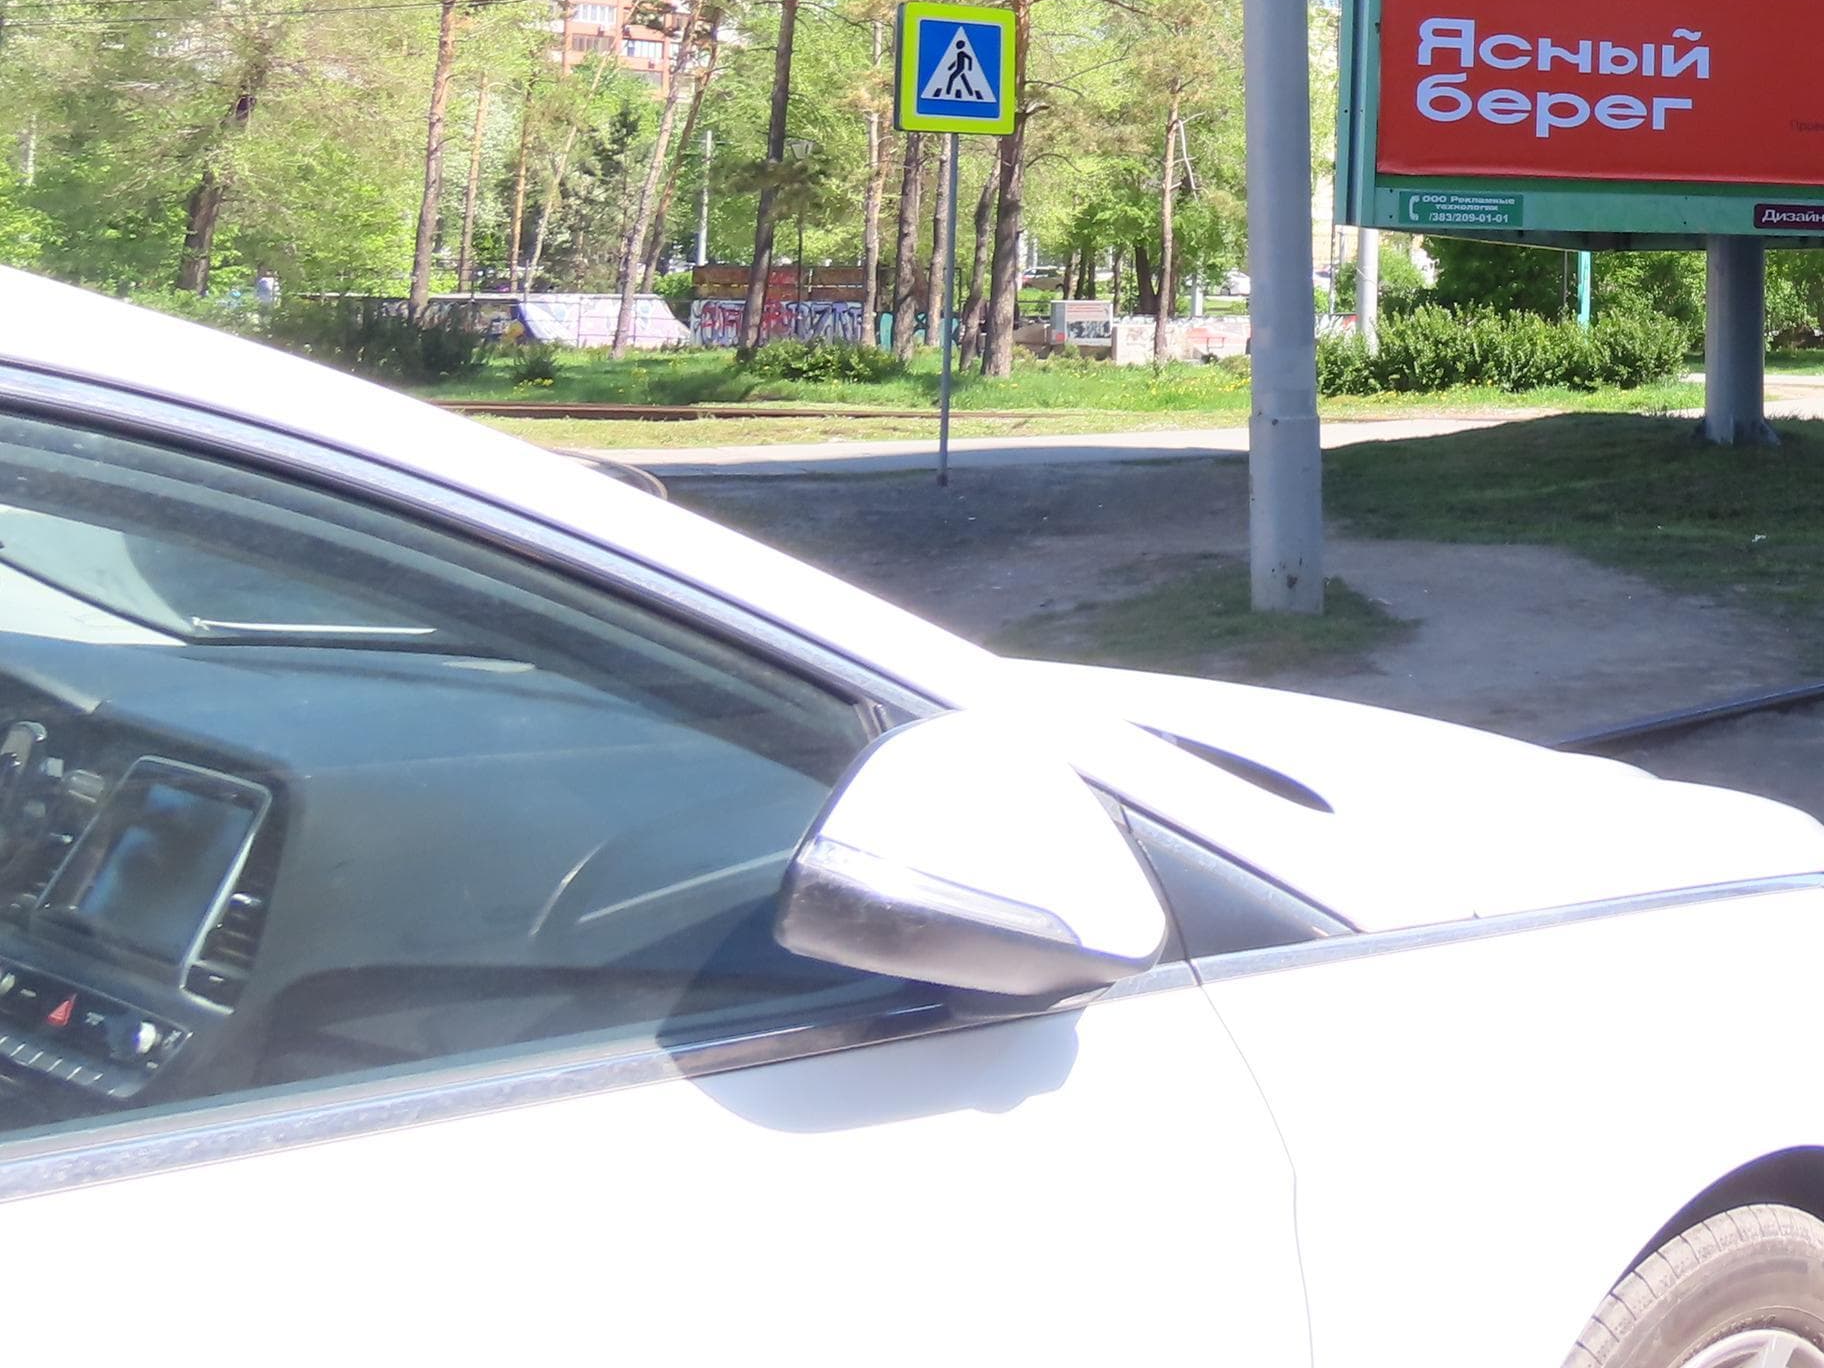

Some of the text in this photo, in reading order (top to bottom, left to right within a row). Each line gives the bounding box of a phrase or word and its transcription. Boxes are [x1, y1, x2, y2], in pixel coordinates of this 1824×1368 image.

[1417, 17, 1710, 80] Ясный
[1416, 71, 1693, 138] берег
[1422, 195, 1516, 205] ООО Рекламные
